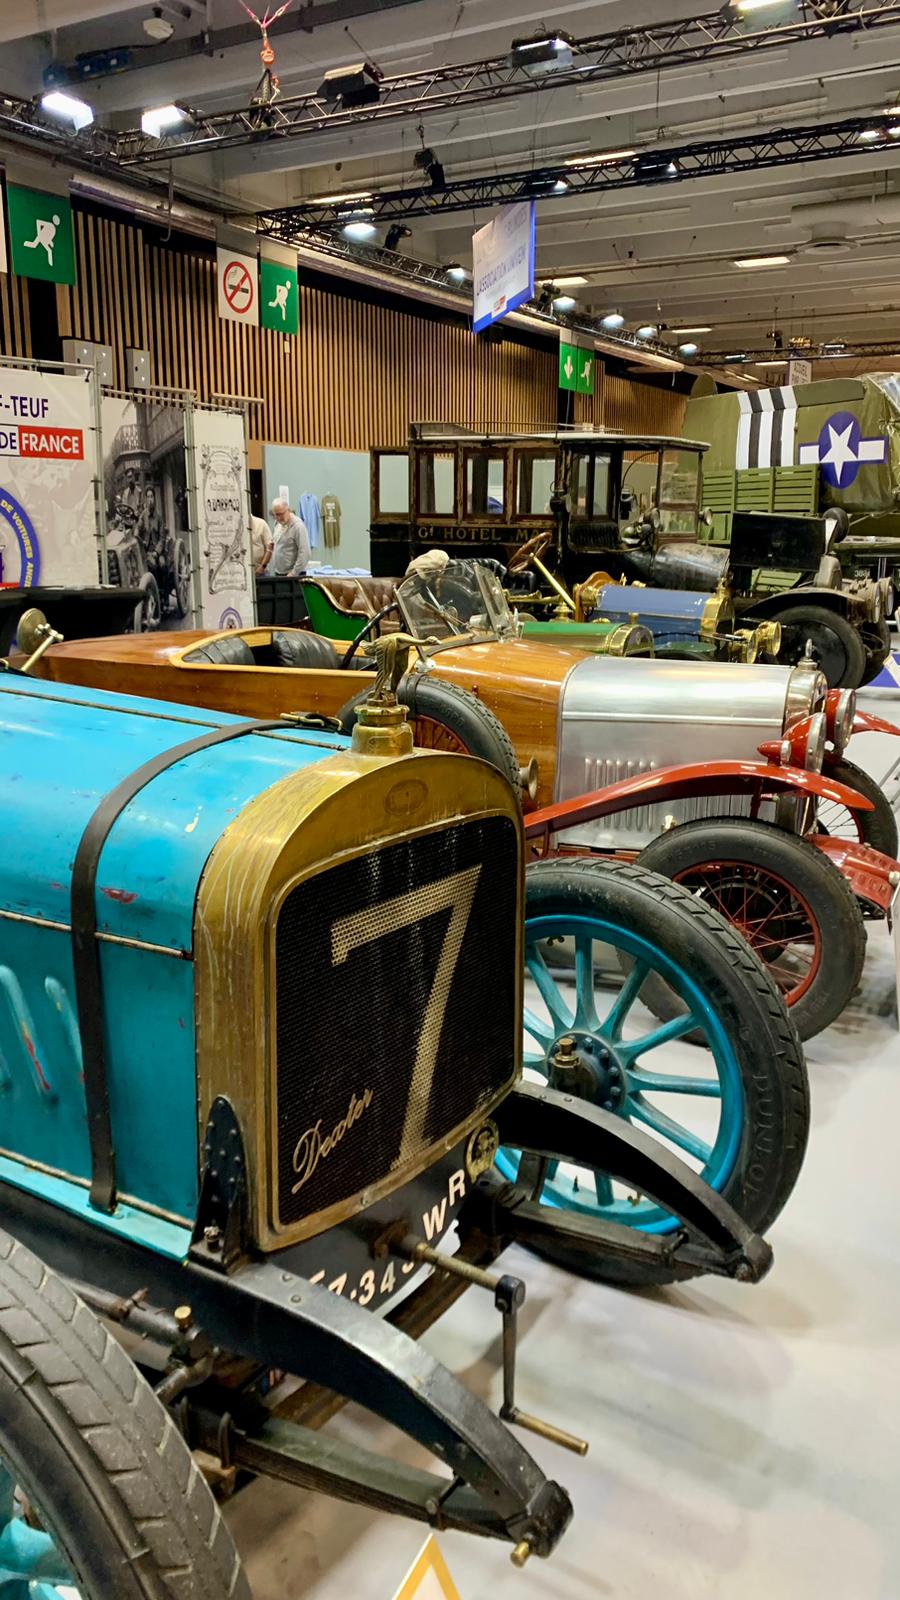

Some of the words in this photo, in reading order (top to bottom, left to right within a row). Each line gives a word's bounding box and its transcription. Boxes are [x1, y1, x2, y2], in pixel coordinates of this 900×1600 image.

[21, 433, 80, 454] FRANCE
[0, 499, 14, 513] DE
[12, 511, 34, 559] VOITURES
[443, 528, 502, 540] HOTEL
[331, 862, 482, 1172] 7
[291, 1088, 374, 1194] Dexter
[422, 1168, 467, 1241] WR
